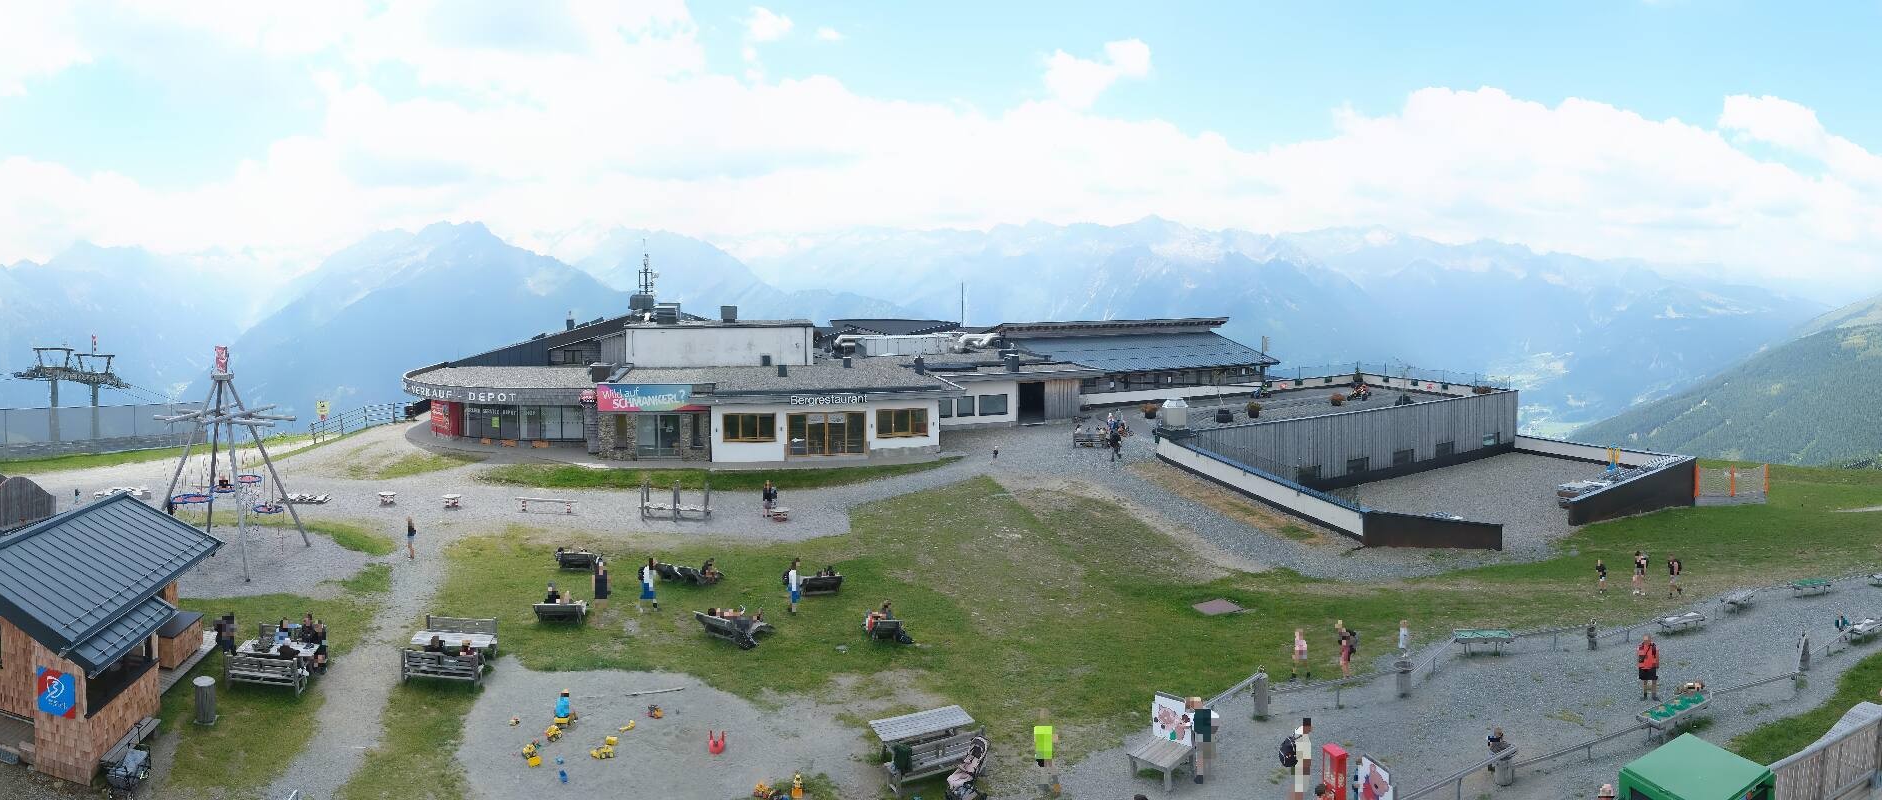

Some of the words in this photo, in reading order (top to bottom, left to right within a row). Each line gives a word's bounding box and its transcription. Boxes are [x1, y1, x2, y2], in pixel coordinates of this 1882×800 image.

[468, 392, 517, 402] DEPOT
[601, 389, 623, 400] Wild
[625, 387, 639, 397] auf
[612, 389, 686, 409] SCHMANKERL?
[790, 394, 868, 406] Bergrestaurant
